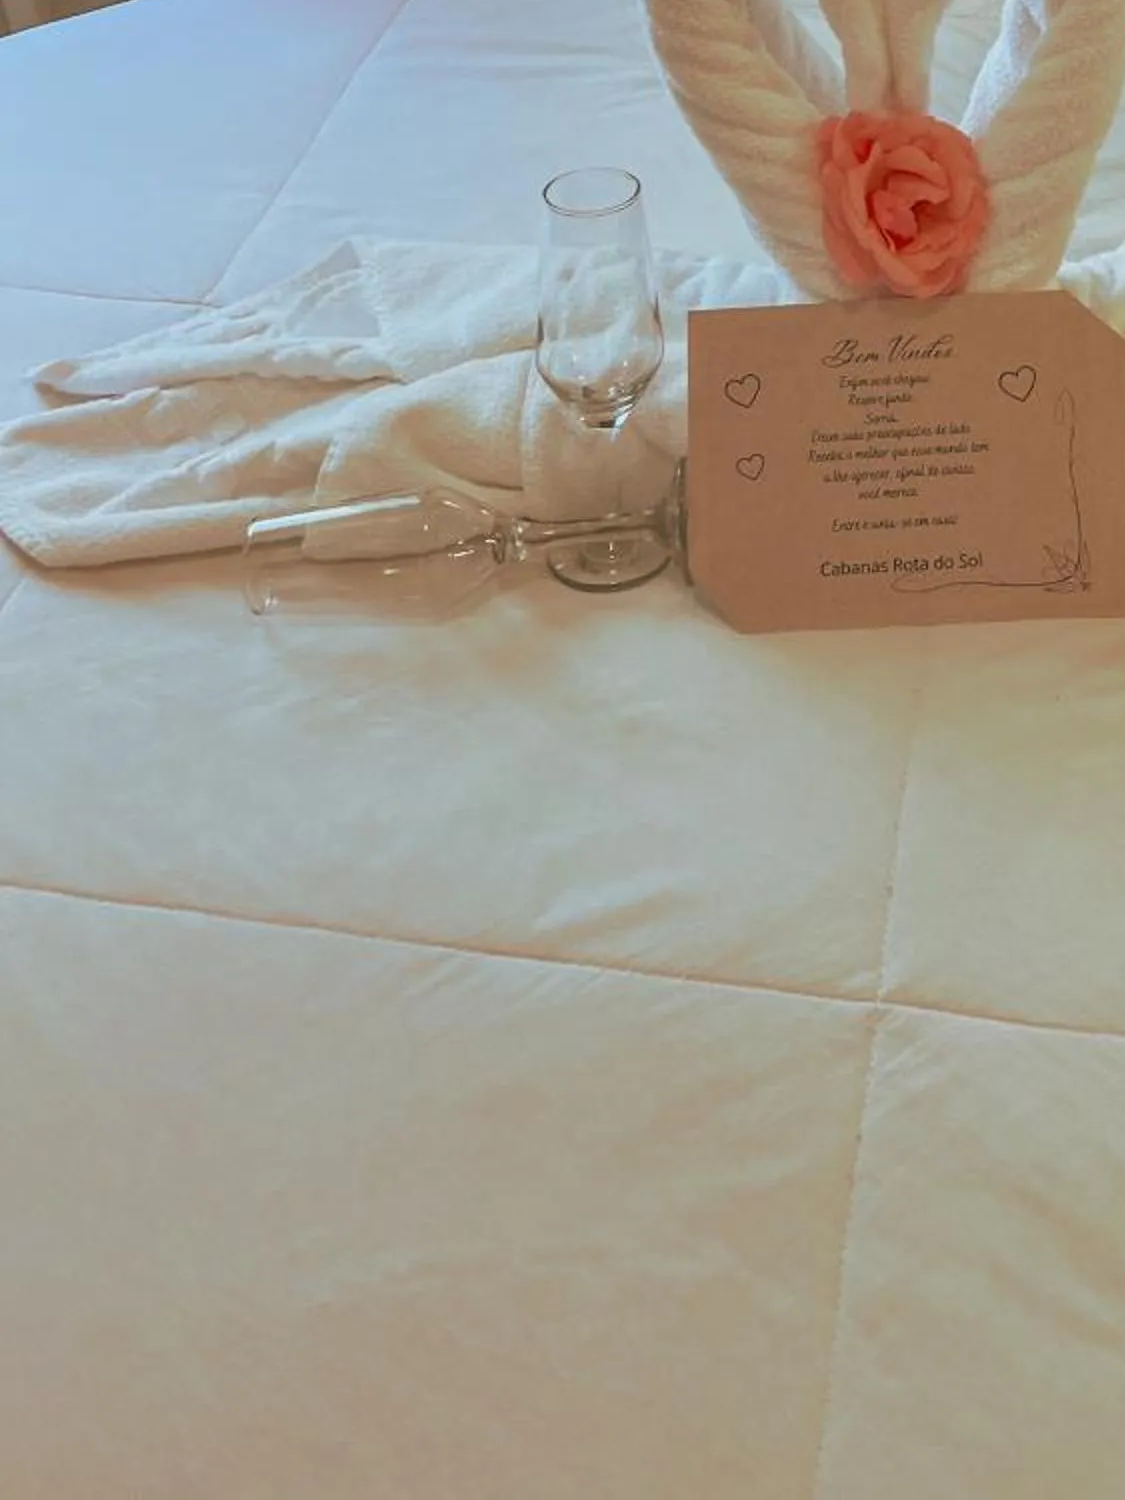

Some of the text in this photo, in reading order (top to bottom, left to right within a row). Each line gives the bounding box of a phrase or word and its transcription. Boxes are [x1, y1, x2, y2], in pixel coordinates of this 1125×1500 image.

[820, 551, 984, 577] Cabanas Rota do Sol
